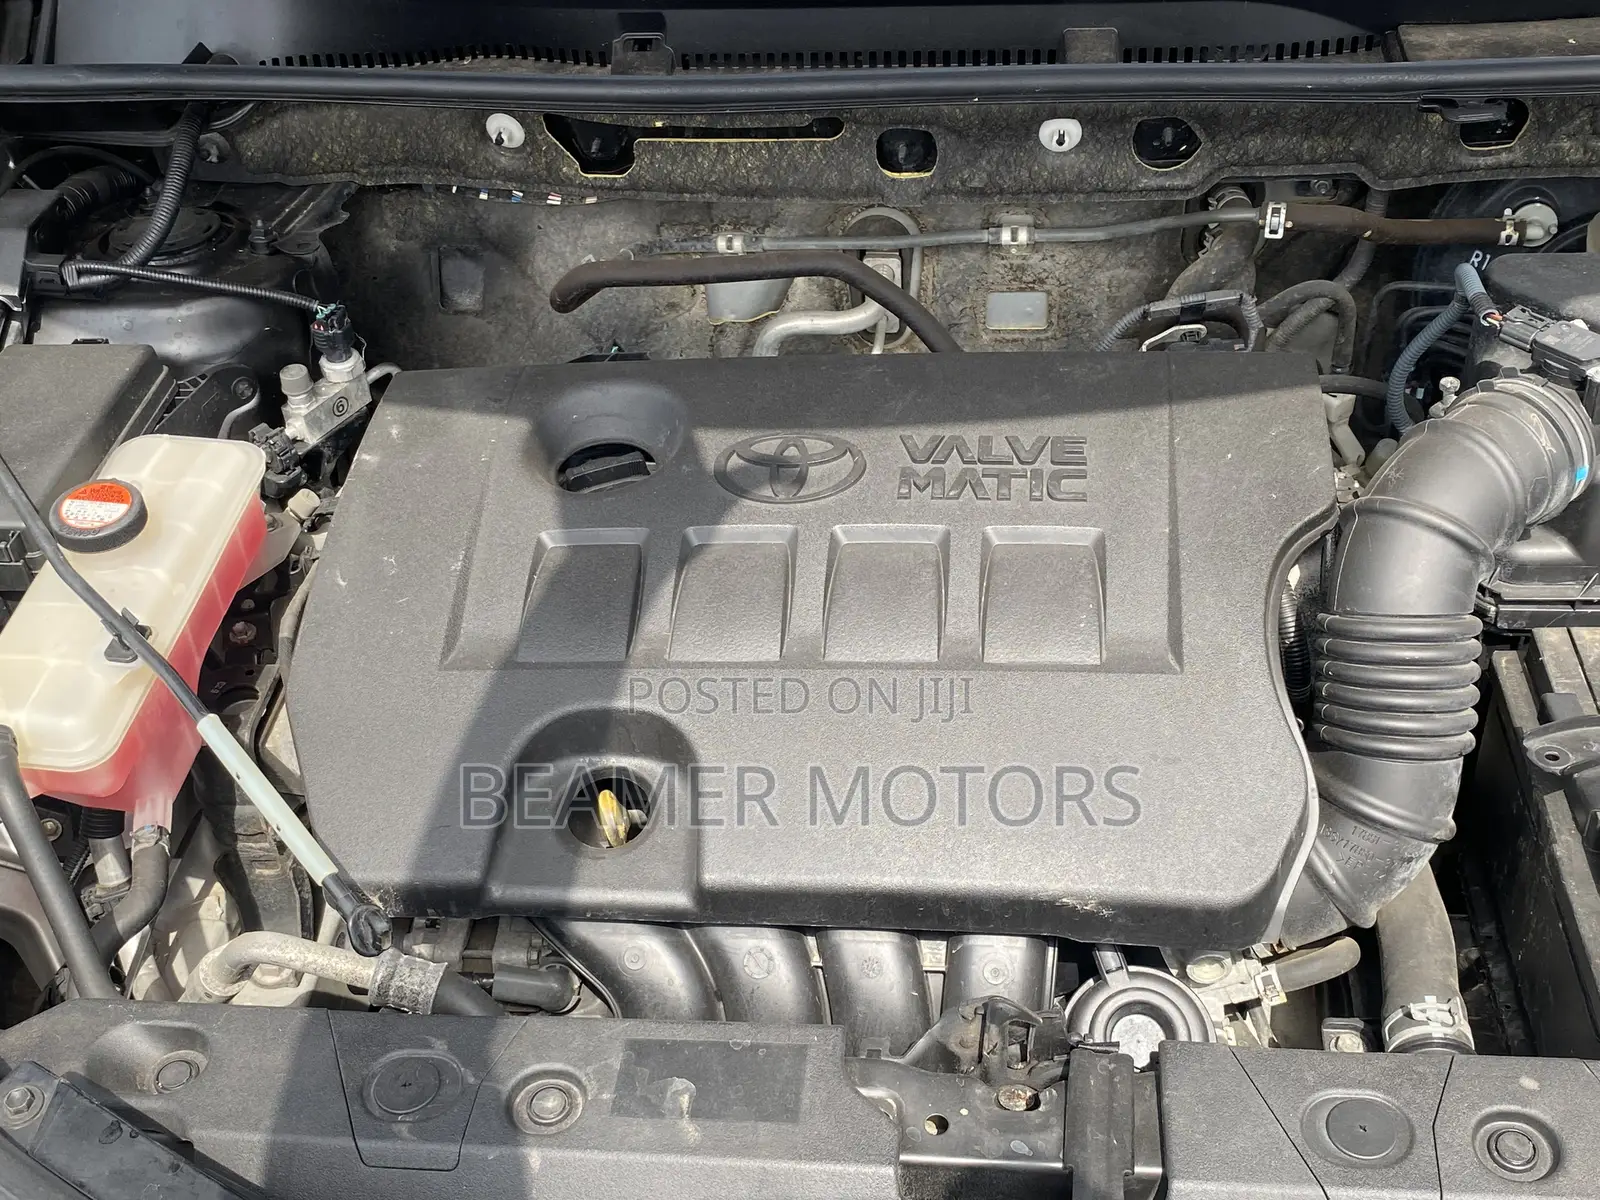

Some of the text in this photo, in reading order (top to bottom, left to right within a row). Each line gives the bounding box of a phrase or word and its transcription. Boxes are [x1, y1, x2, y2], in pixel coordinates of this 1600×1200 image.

[334, 398, 347, 415] 6
[899, 434, 1088, 466] VALVE
[897, 466, 1088, 502] MATIC
